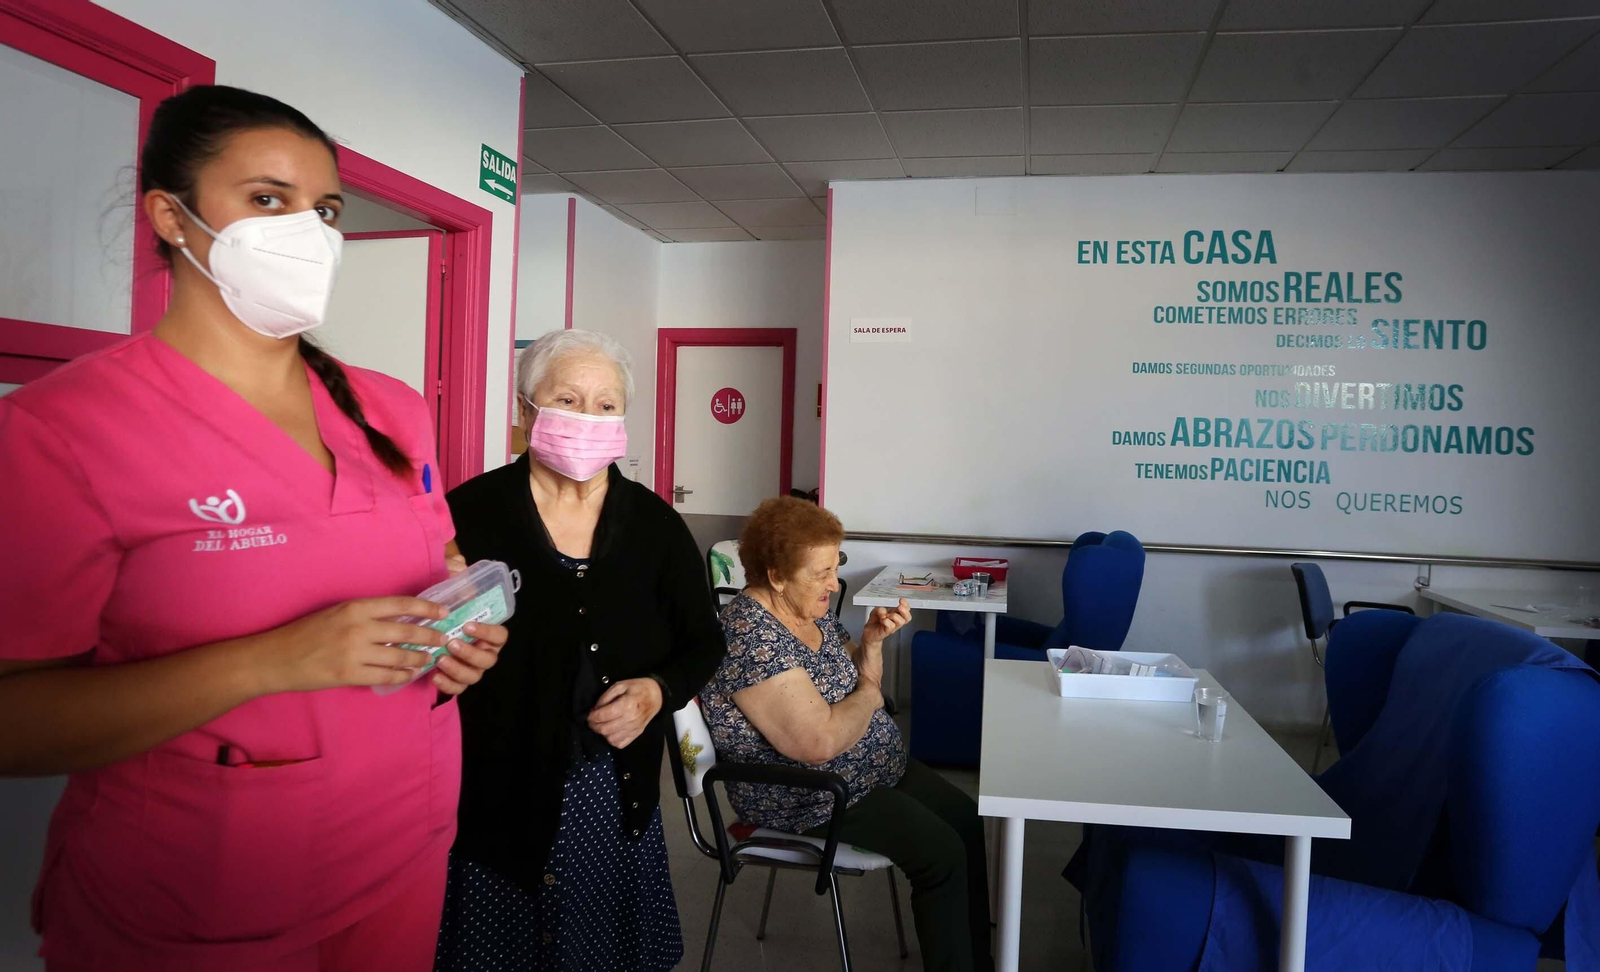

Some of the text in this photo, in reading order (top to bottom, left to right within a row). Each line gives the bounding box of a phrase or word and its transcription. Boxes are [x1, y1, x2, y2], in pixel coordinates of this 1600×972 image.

[482, 150, 517, 184] SALIDA
[1077, 229, 1277, 265] EN ESTA CASA
[1196, 271, 1403, 304] SOMOS REALES
[1153, 305, 1358, 326] COMETEMOS ERRORES
[1276, 334, 1342, 349] DECIMOS
[1371, 318, 1487, 351] SIENTO
[1132, 362, 1336, 377] DAMOS SEGUNDAS OPORTUNIDADES
[1255, 382, 1464, 412] NOS DIVERTIMOS
[1112, 416, 1535, 456] DAMOS ABRAZOS PERDONAMOS
[1135, 457, 1331, 485] TENEMOS PACIENCIA
[1265, 490, 1464, 515] NOS QUEREMOS
[193, 533, 288, 552] DEL ABUELO
[208, 525, 273, 539] EL HOGAR
